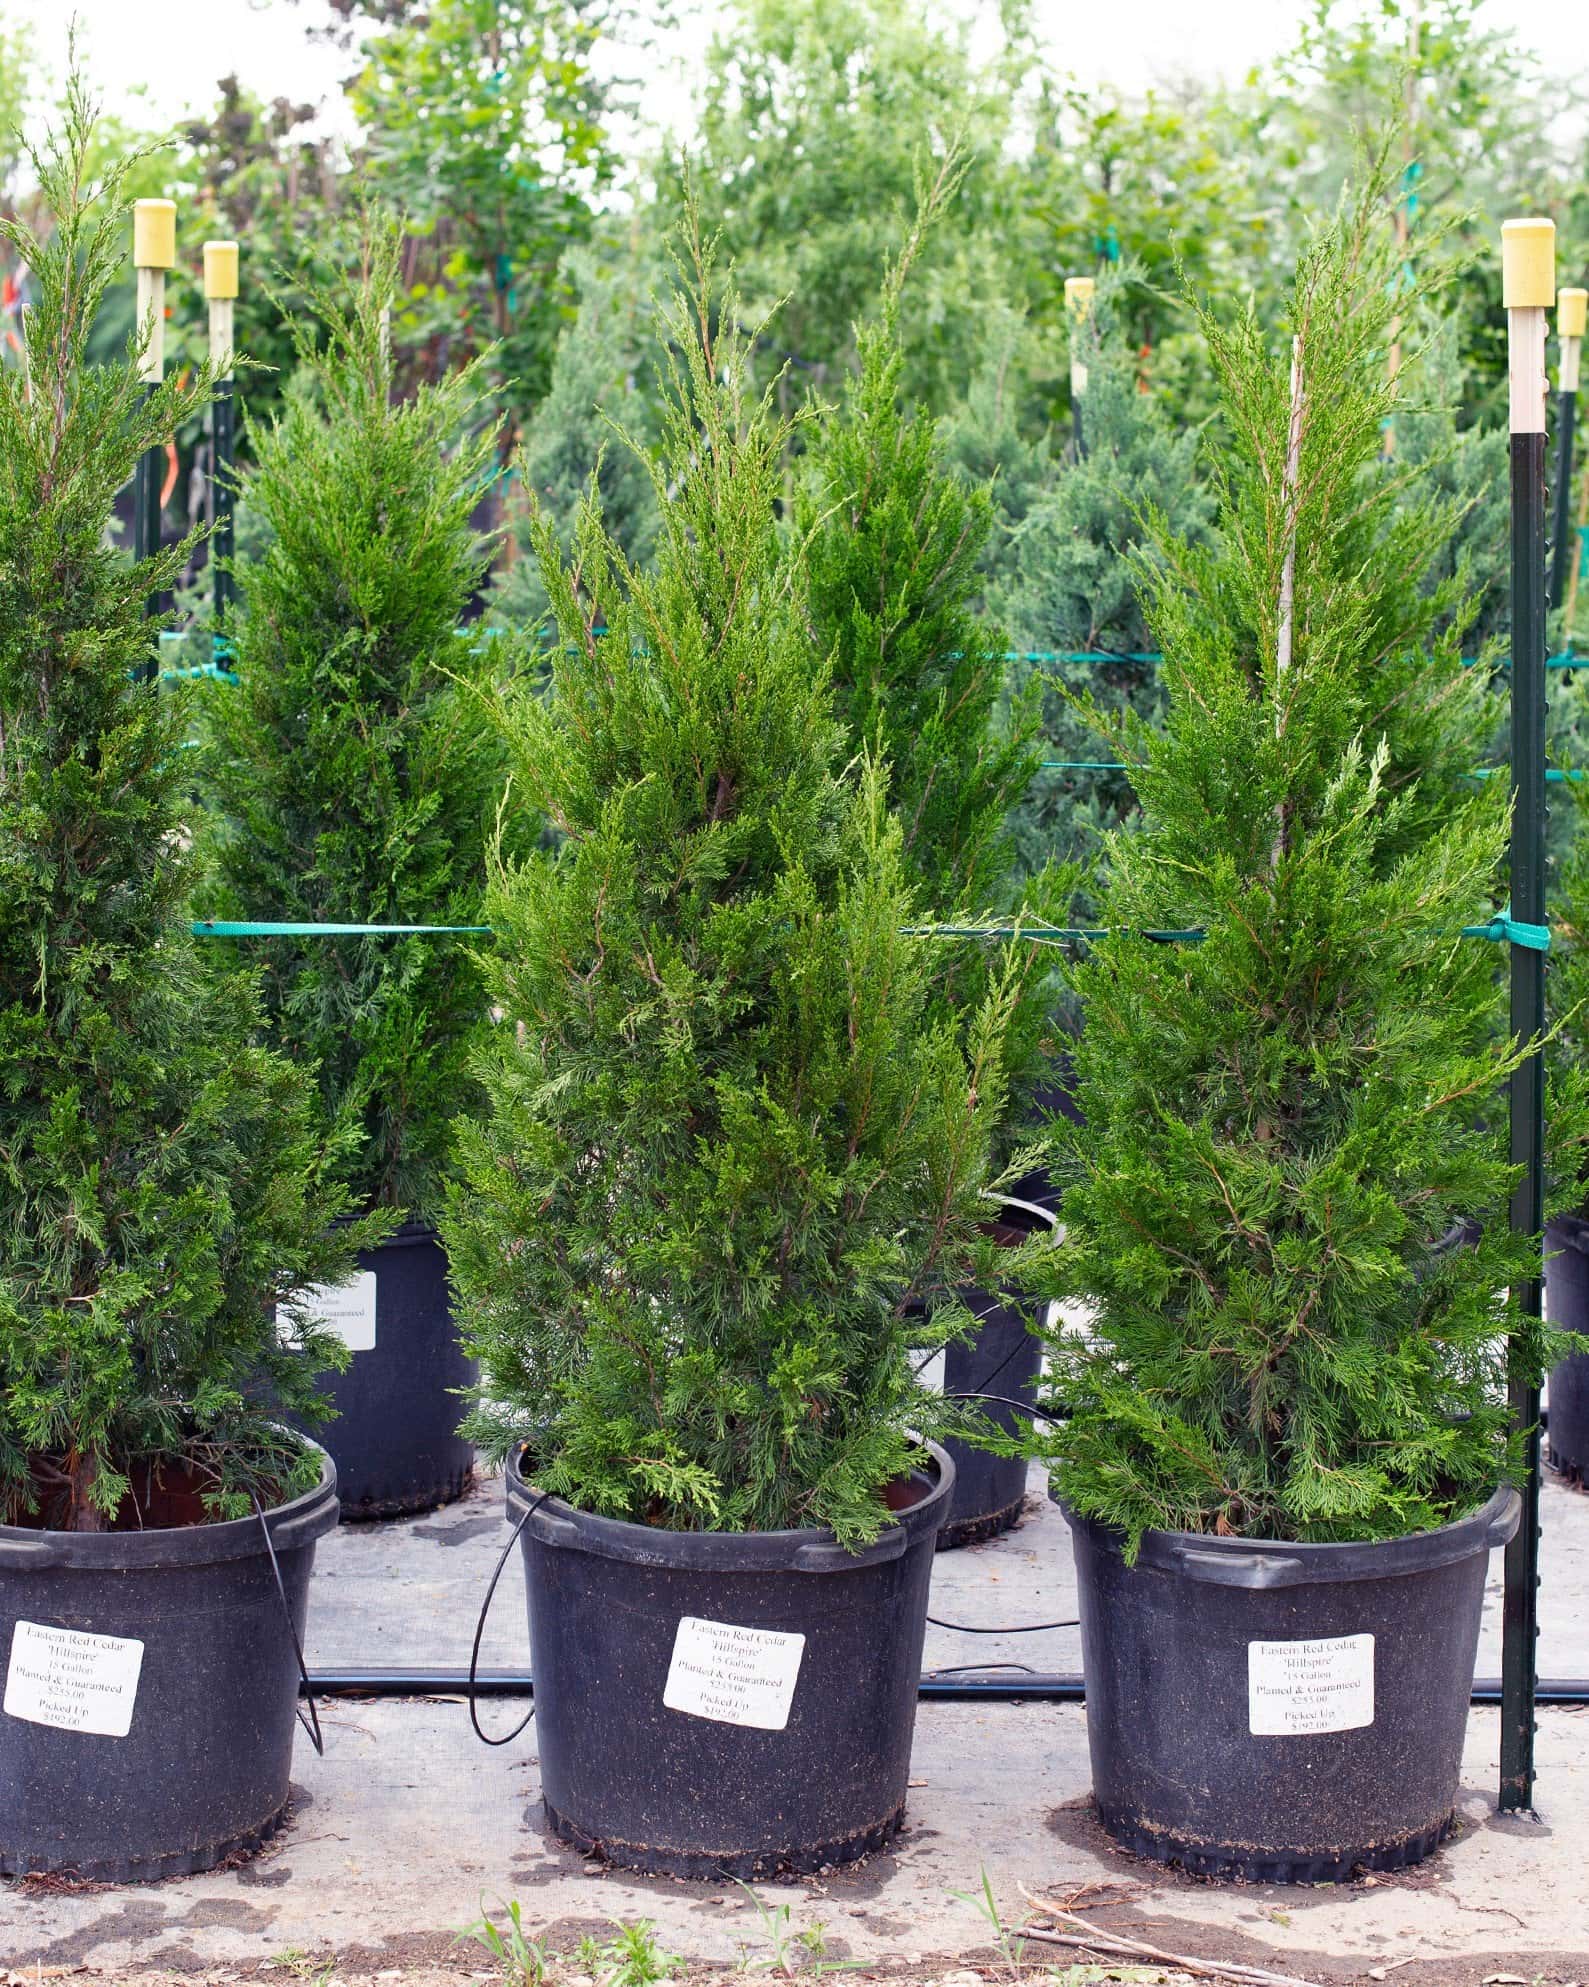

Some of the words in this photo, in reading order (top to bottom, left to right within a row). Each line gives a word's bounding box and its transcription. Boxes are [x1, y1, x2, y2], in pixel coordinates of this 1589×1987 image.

[321, 1307, 365, 1317] Guaranteed
[27, 1626, 65, 1643] Eastern
[69, 1634, 90, 1646] Red
[93, 1639, 125, 1651] Cedar
[691, 1621, 729, 1638] Eastern
[733, 1630, 754, 1642] Red
[756, 1635, 786, 1646] Cedar
[1261, 1646, 1301, 1655] Eastern
[1303, 1643, 1323, 1654] Red
[1326, 1641, 1357, 1652] Cedar
[49, 1660, 59, 1669] 15
[61, 1663, 93, 1675] Gallon
[712, 1656, 722, 1664] 15
[724, 1658, 755, 1670] Gallon
[16, 1665, 51, 1682] Planted
[53, 1675, 63, 1685] &
[66, 1680, 122, 1694] Guaranteed
[678, 1660, 714, 1676] Planted
[716, 1669, 724, 1679] &
[728, 1672, 783, 1688] Guaranteed
[1301, 1671, 1332, 1680] Gallon
[1256, 1686, 1292, 1695] Planted
[1295, 1686, 1304, 1694] &
[1307, 1680, 1361, 1693] Guaranteed
[39, 1698, 71, 1714] Picked
[74, 1705, 89, 1717] Up
[700, 1692, 732, 1706] Picked
[735, 1700, 750, 1712] Up
[1284, 1711, 1317, 1720] Picked
[1320, 1708, 1335, 1720] Up
